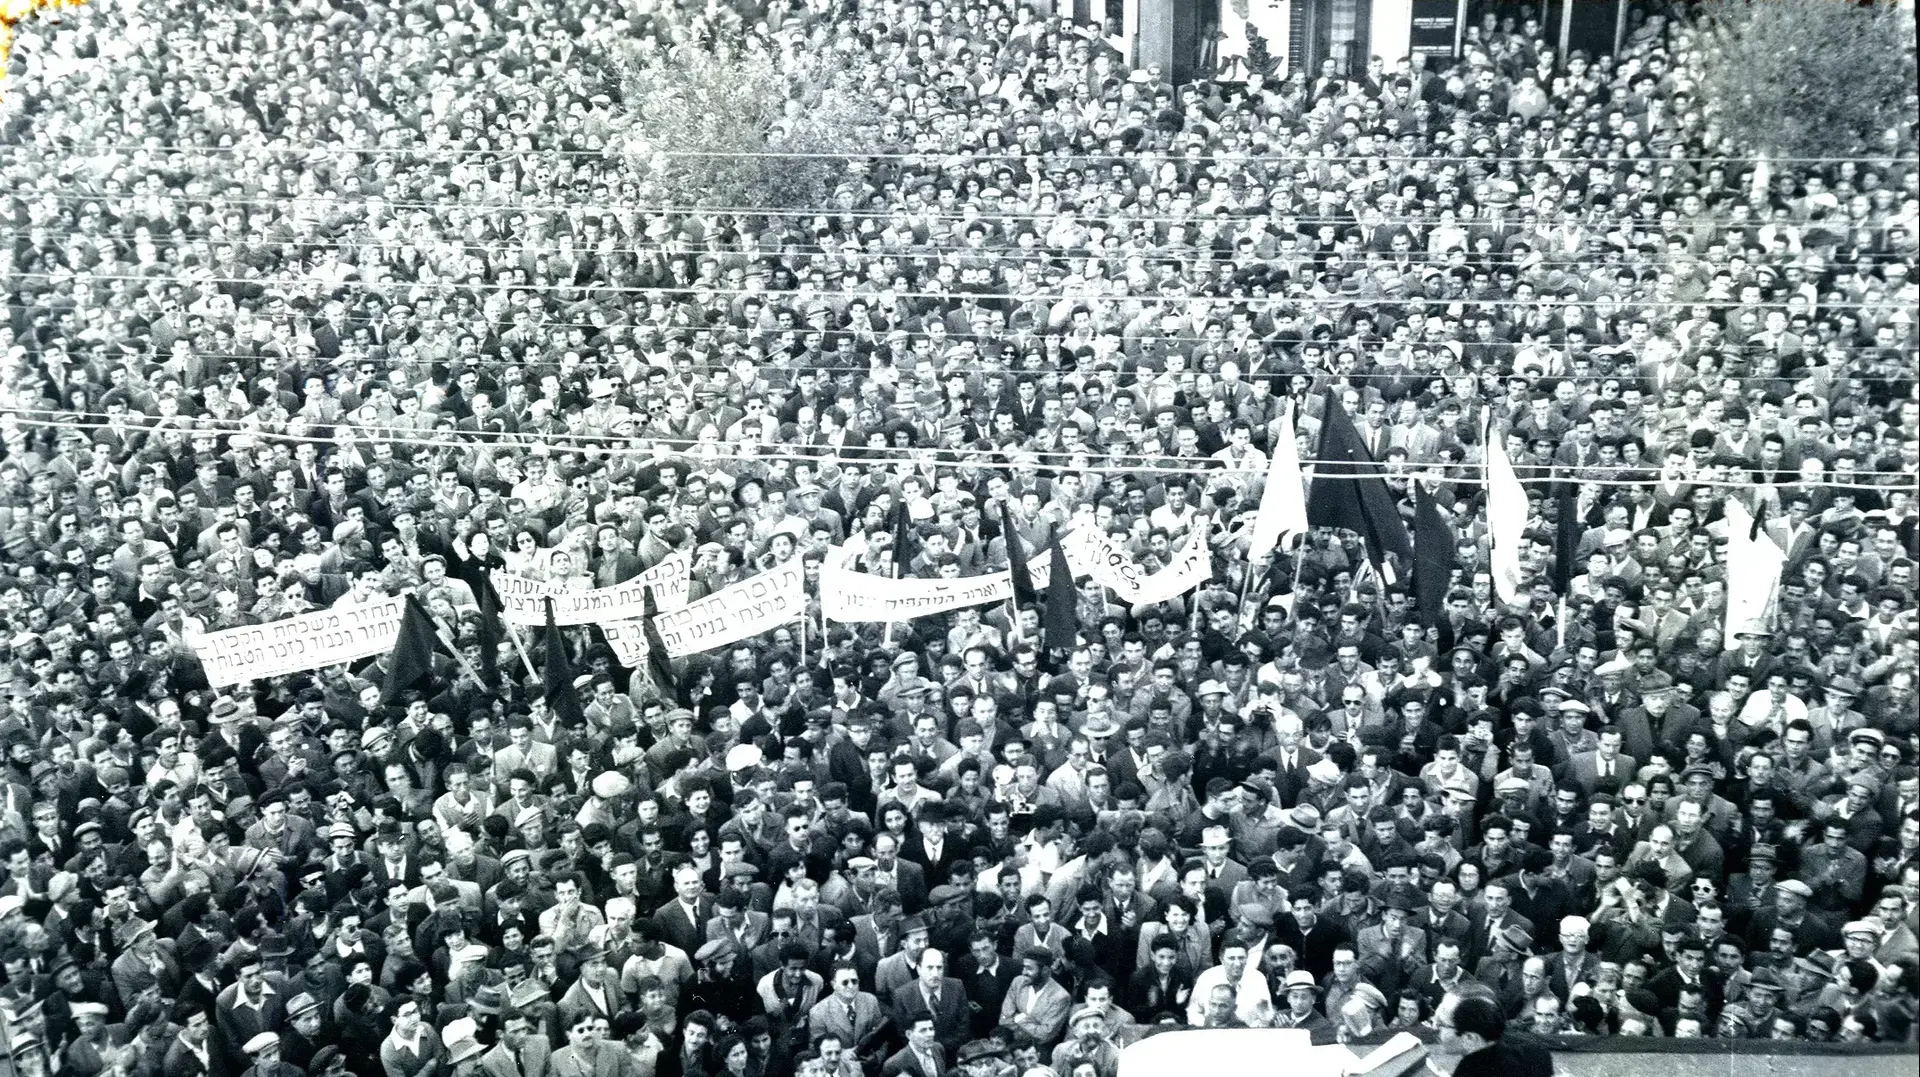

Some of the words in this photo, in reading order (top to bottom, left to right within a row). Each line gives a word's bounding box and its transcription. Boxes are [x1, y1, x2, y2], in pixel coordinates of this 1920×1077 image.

[619, 582, 665, 605] חפת
[733, 571, 797, 601] תוסר
[962, 583, 998, 599] וארור
[347, 603, 398, 622] תחזר
[572, 594, 613, 612] המגע
[732, 596, 786, 623] מרצחי
[660, 598, 726, 632] חרפת
[689, 617, 727, 639] בנינו
[268, 638, 304, 658] לזכר
[310, 630, 353, 649] הכבוד
[200, 648, 264, 671] הטבוחי
